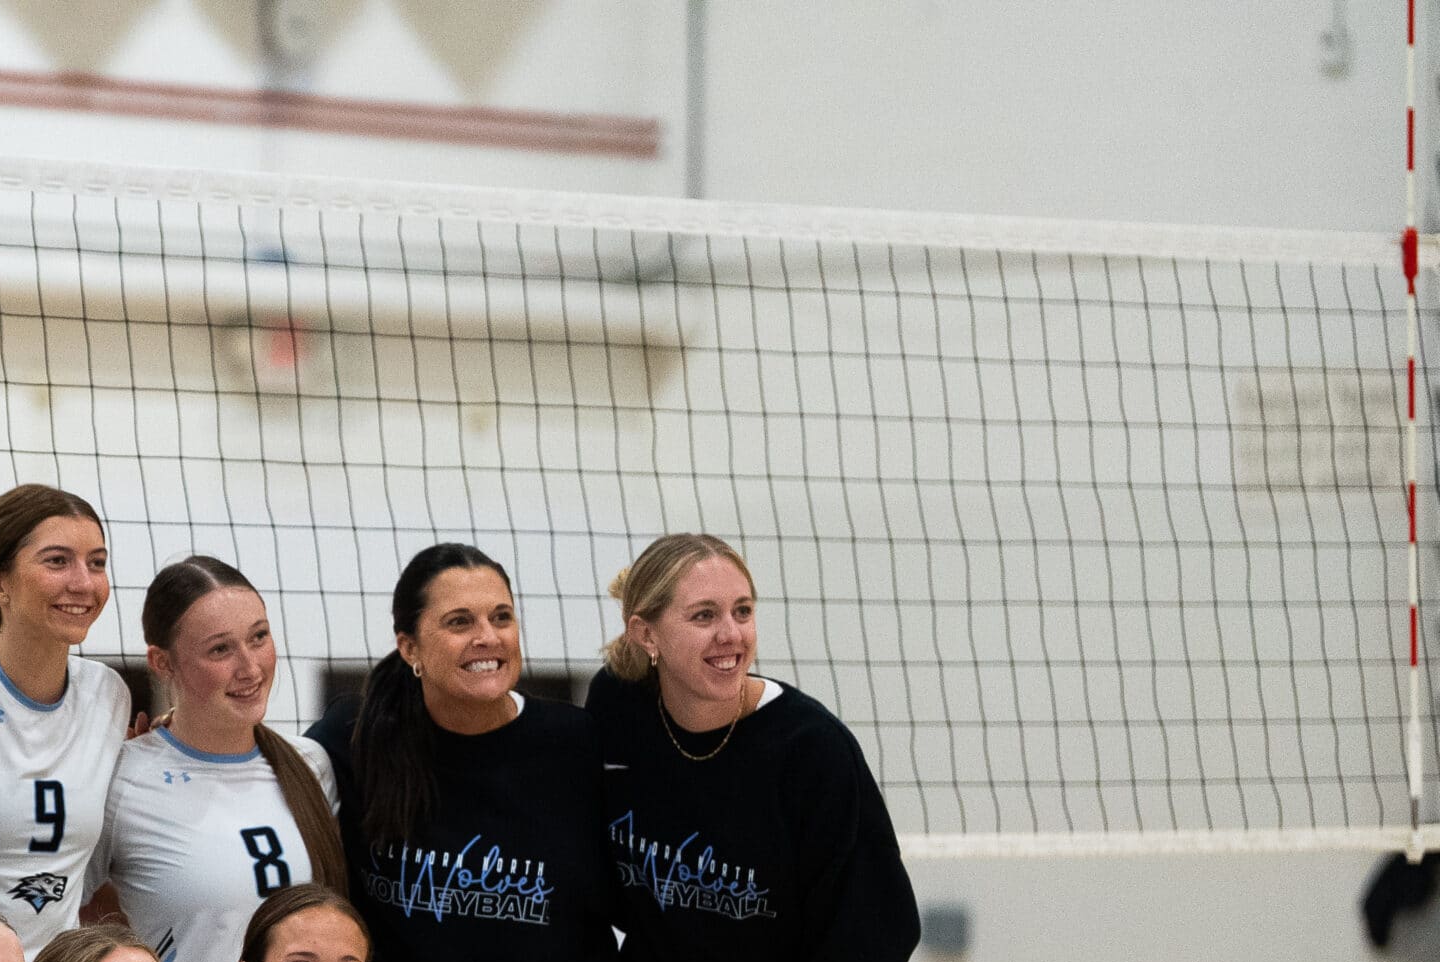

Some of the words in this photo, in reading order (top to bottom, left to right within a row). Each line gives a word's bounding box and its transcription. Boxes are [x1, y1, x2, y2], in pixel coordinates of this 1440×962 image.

[28, 780, 66, 853] 9
[240, 826, 291, 898] 8
[370, 834, 554, 922] Wolves
[483, 856, 544, 876] NORTH
